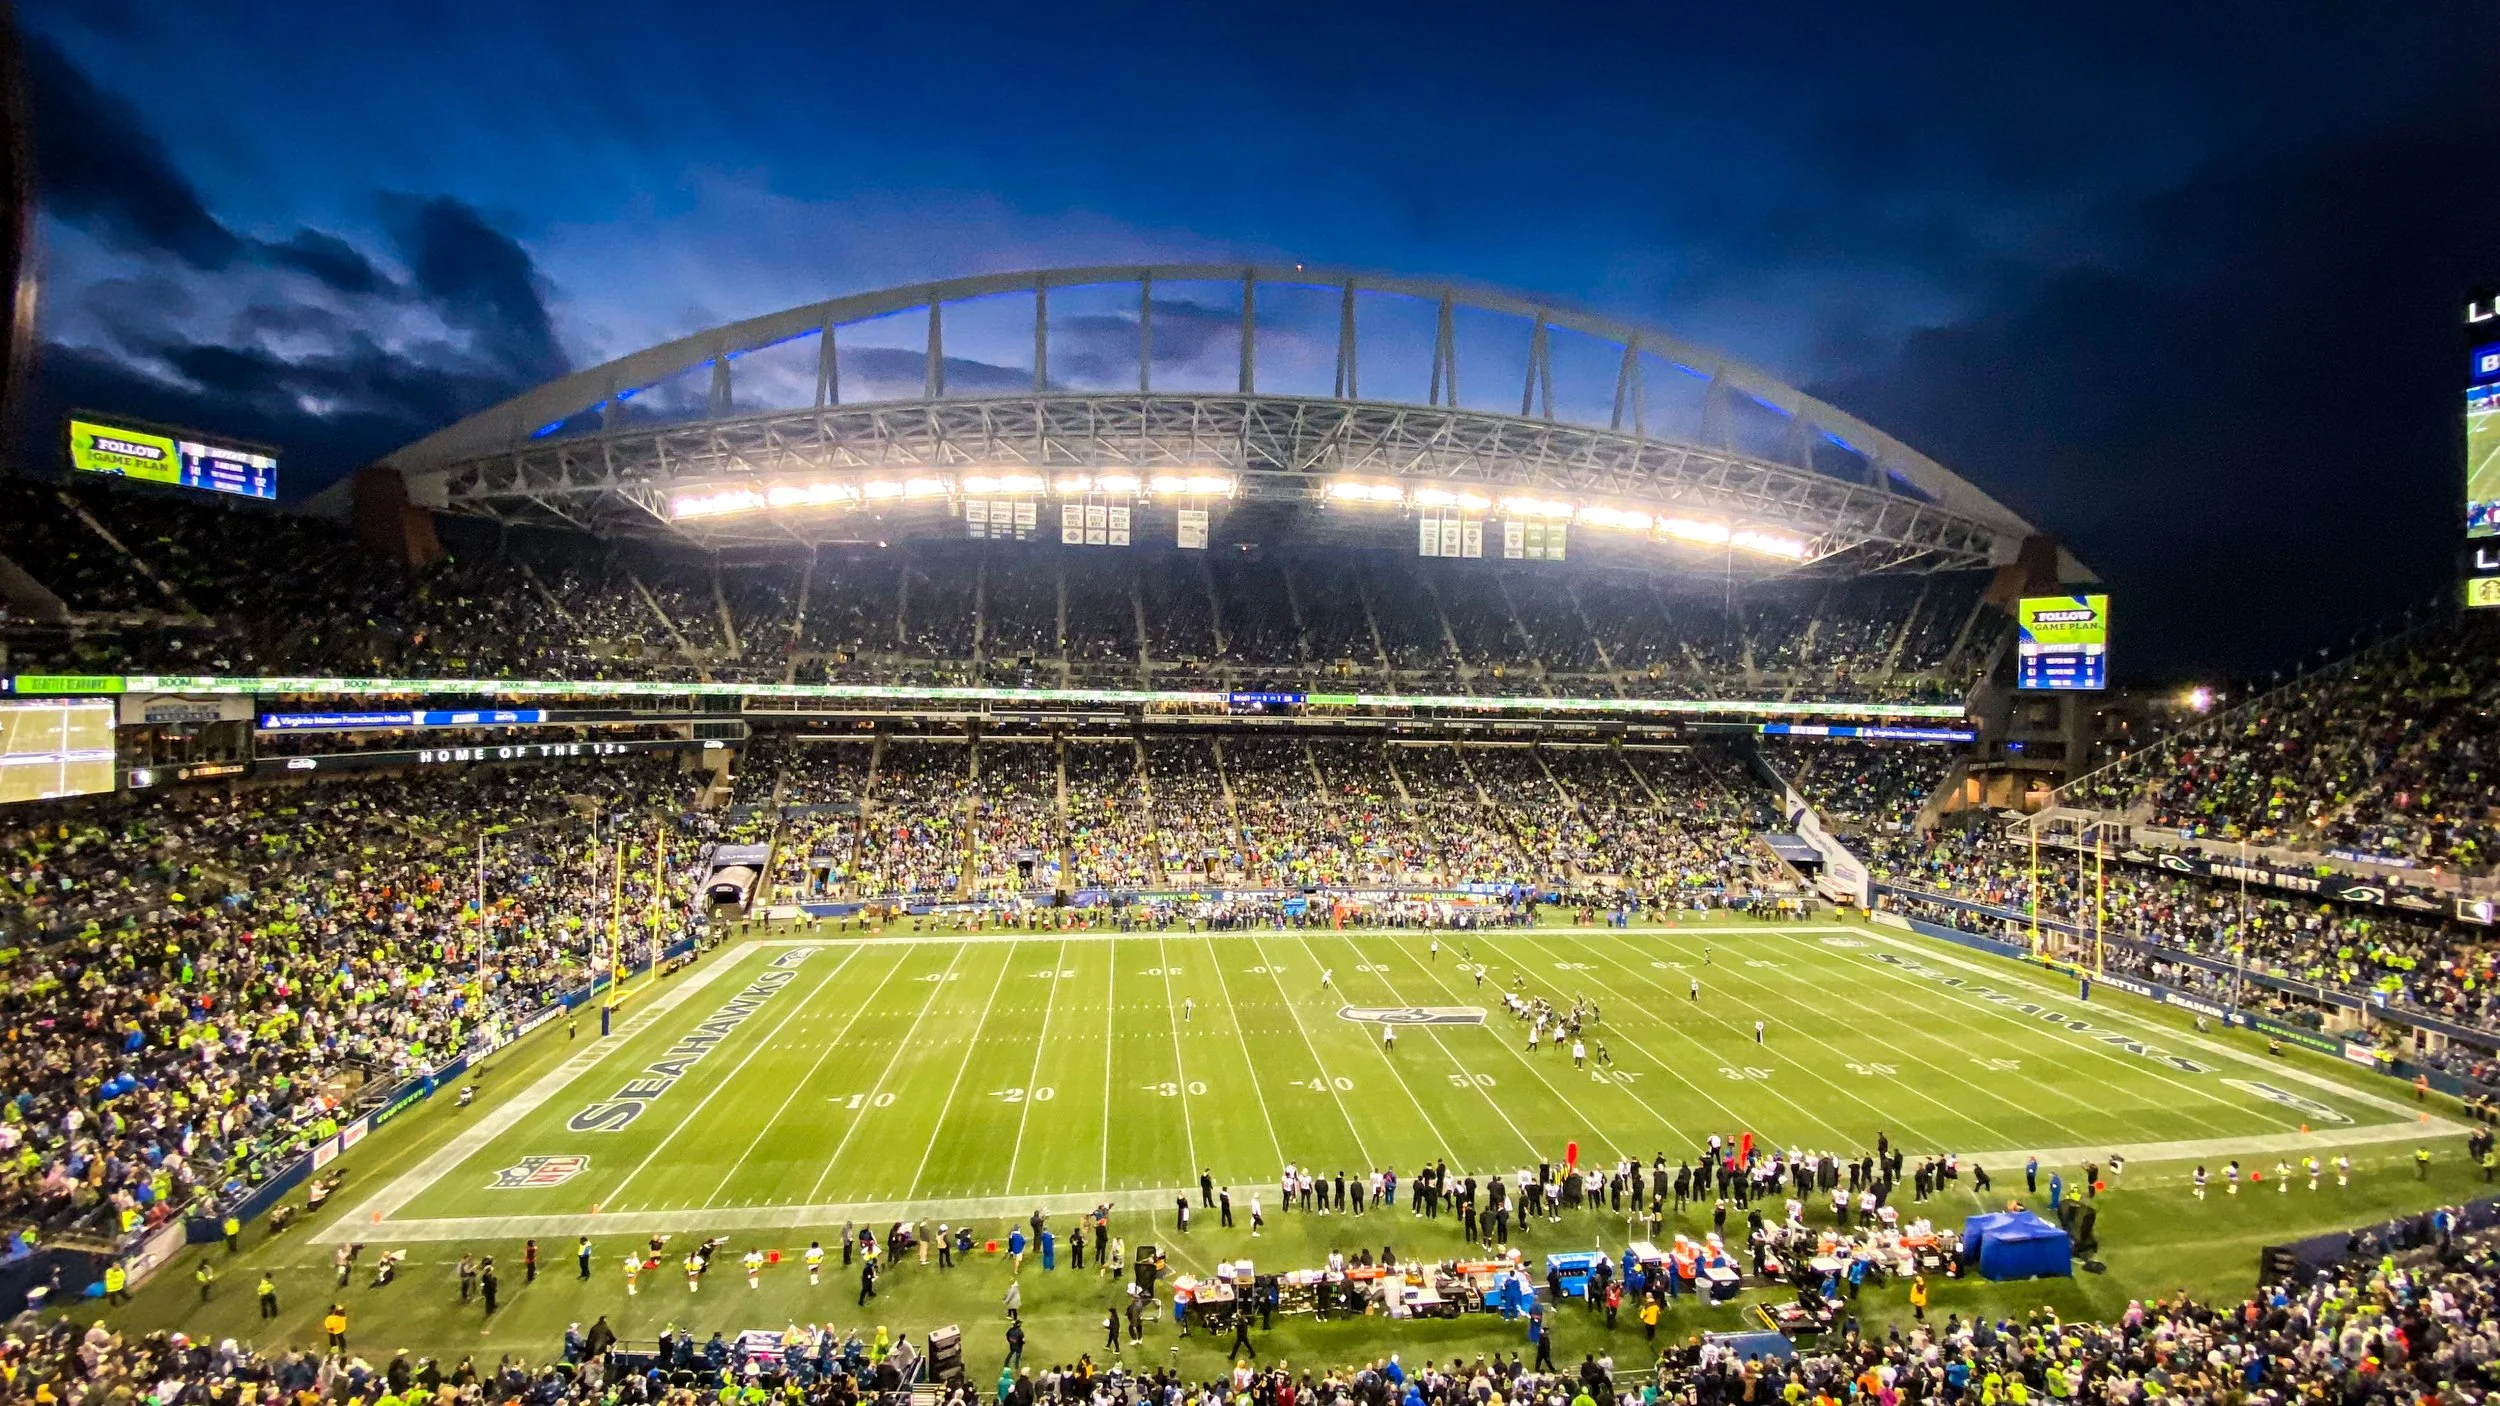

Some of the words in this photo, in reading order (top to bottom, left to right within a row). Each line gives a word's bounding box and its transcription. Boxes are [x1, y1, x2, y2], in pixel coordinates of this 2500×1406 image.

[98, 438, 161, 459] FOLLOW
[93, 453, 132, 466] GAME
[135, 459, 168, 472] PLAN
[2038, 611, 2092, 622] FOLLOW
[2069, 622, 2098, 631] PLAN
[158, 677, 192, 686] BOOM
[343, 680, 372, 688] BOOM
[500, 681, 524, 689] BOOM
[280, 717, 314, 727] Virginia
[314, 716, 342, 724] Mason
[343, 715, 384, 723] Franciscan
[385, 714, 412, 723] Health
[420, 750, 485, 763] HOME
[500, 747, 527, 759] OF
[541, 744, 580, 757] THE
[2210, 863, 2270, 886] HAWKS
[2275, 873, 2321, 893] NEST
[1861, 951, 2222, 1074] SEAHAWKS
[466, 1032, 514, 1068] SEATTLE
[518, 1007, 563, 1036] SEAHAW
[567, 968, 798, 1133] SEAHAWKS
[1590, 1070, 1635, 1085] 40
[1717, 1066, 1769, 1081] 30
[1845, 1062, 1897, 1077] 20
[1305, 1076, 1354, 1093] 40
[1447, 1073, 1497, 1088] 50
[1002, 1086, 1056, 1103] 20
[1156, 1081, 1208, 1098] 30
[843, 1092, 896, 1110] 10
[528, 1155, 588, 1185] NFL
